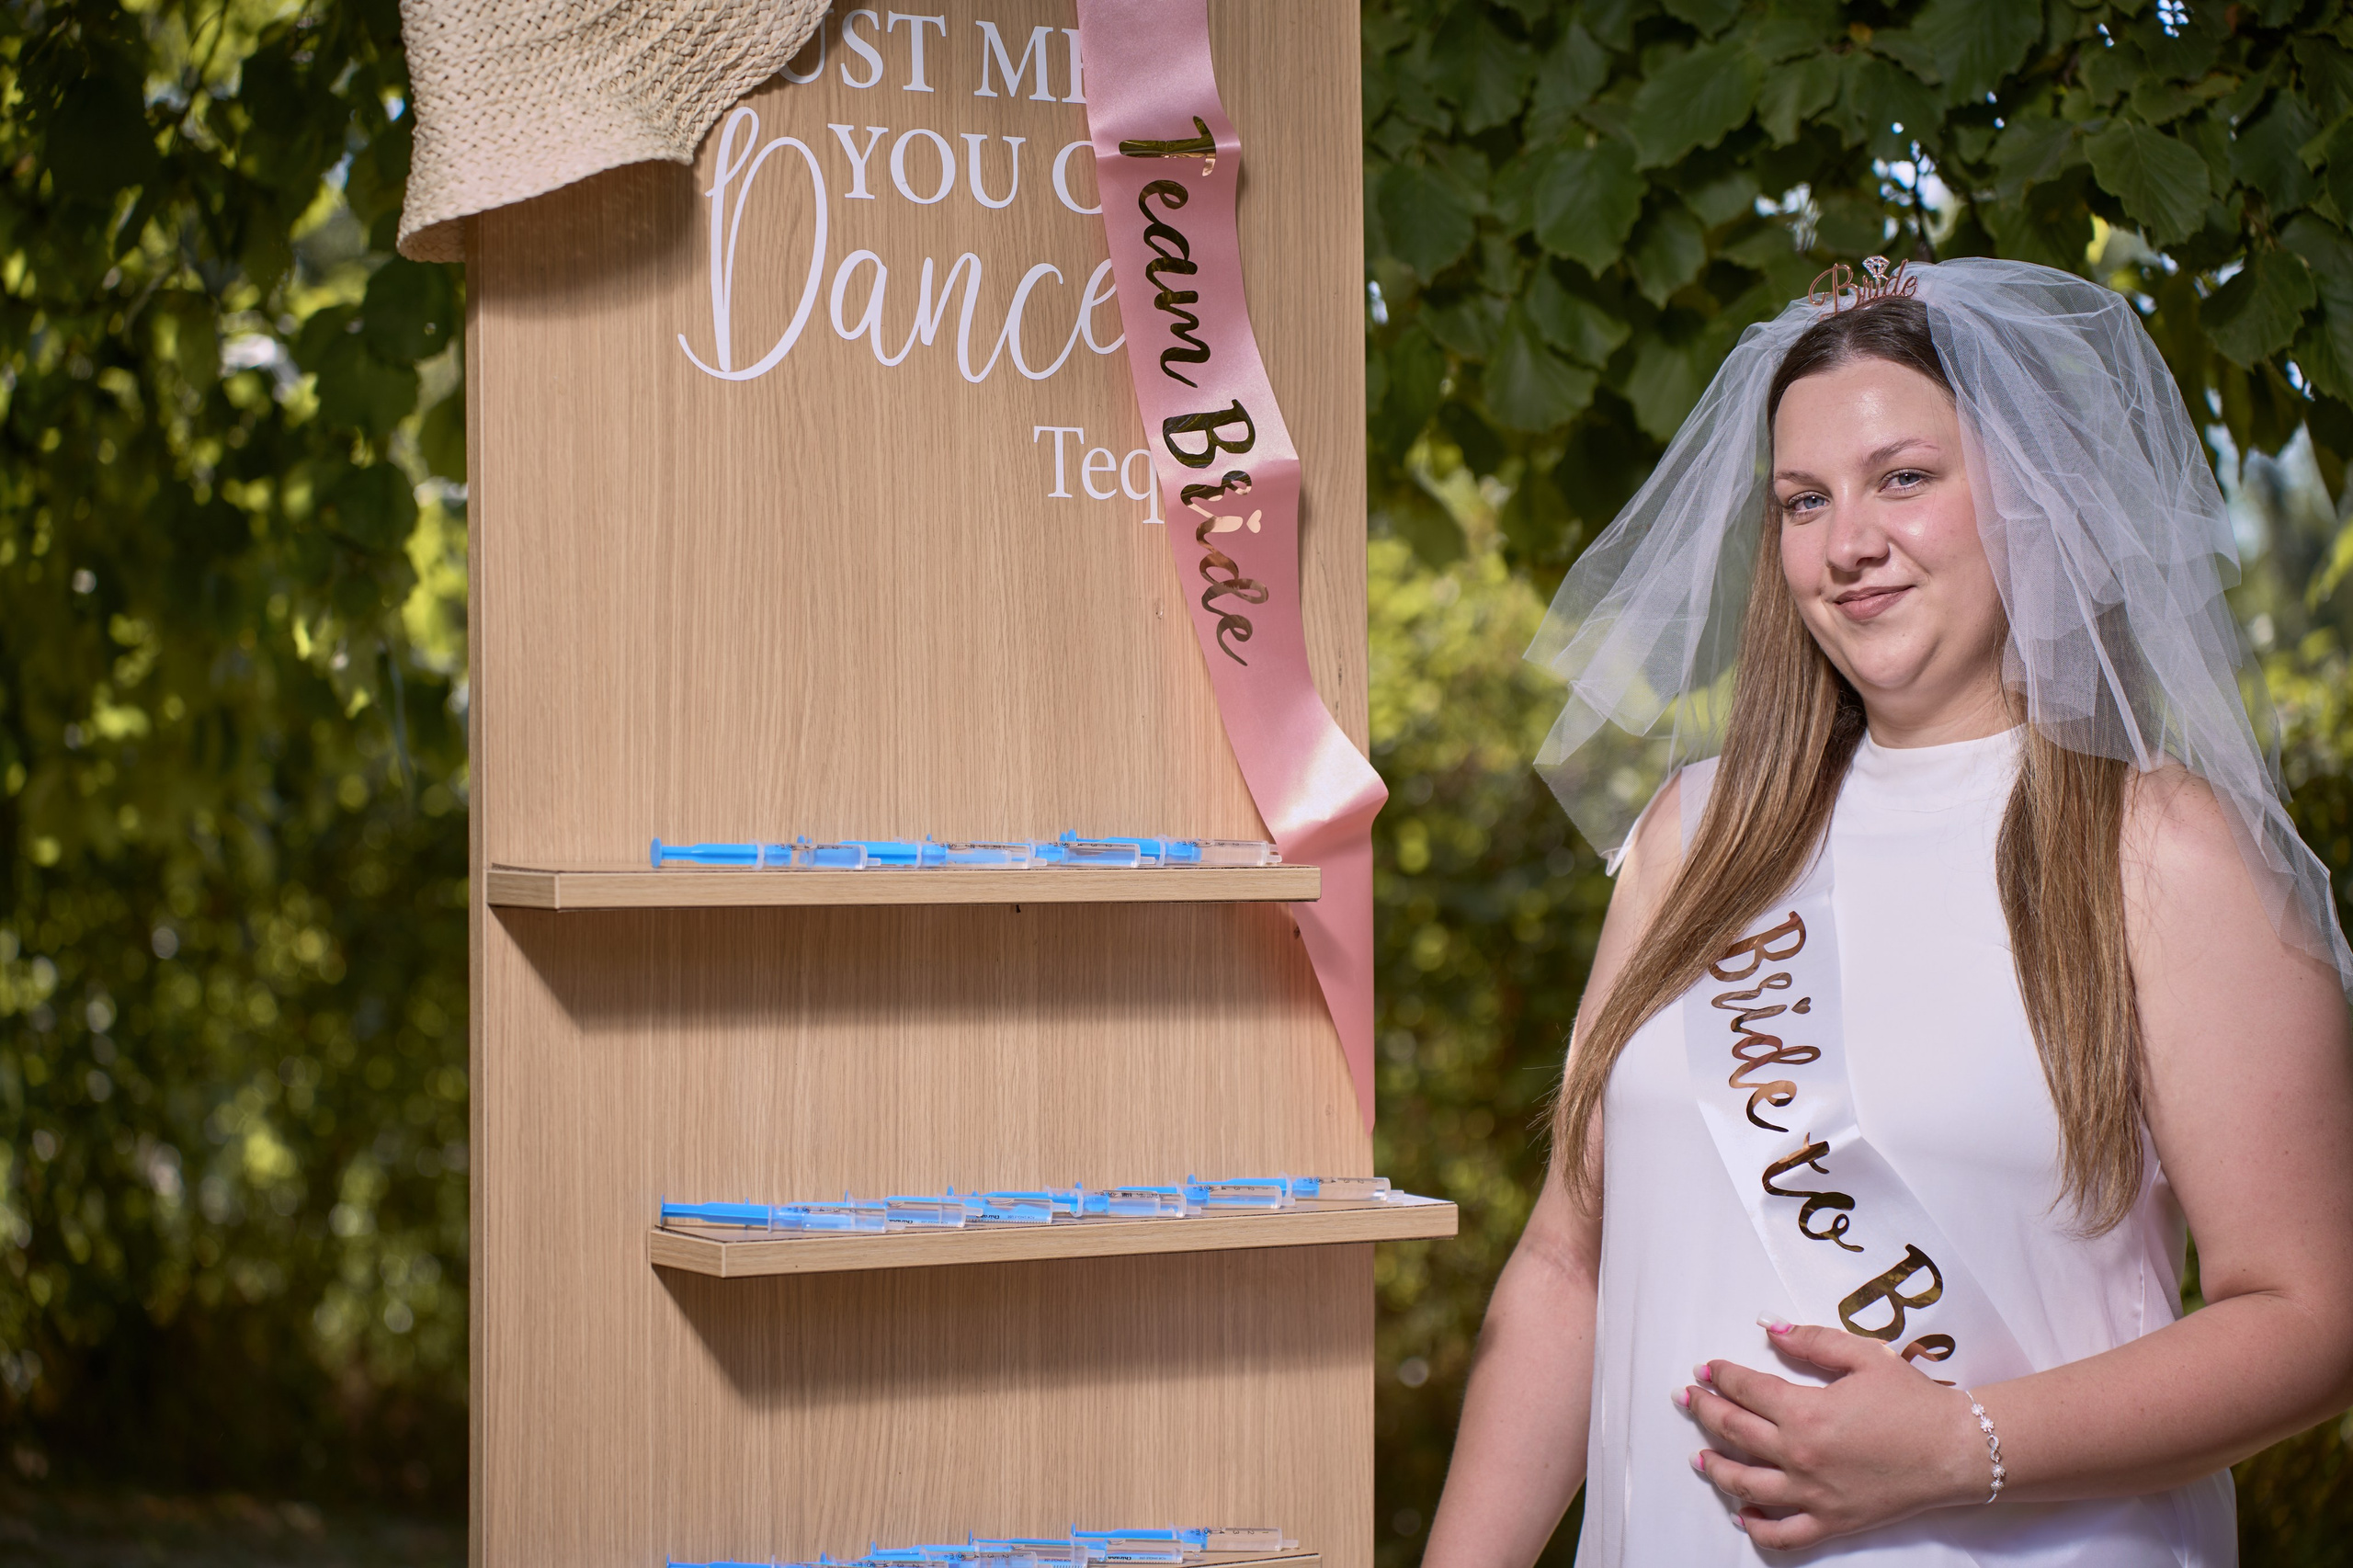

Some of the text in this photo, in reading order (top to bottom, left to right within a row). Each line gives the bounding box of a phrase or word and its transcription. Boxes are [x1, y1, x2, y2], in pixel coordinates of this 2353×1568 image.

[677, 106, 1126, 383] Dance
[827, 122, 1026, 209] YOU
[1808, 257, 1918, 314] Bride
[1033, 426, 1165, 525] Teq
[1118, 116, 1269, 666] Team Bride
[1709, 911, 1956, 1386] Bride to Be
